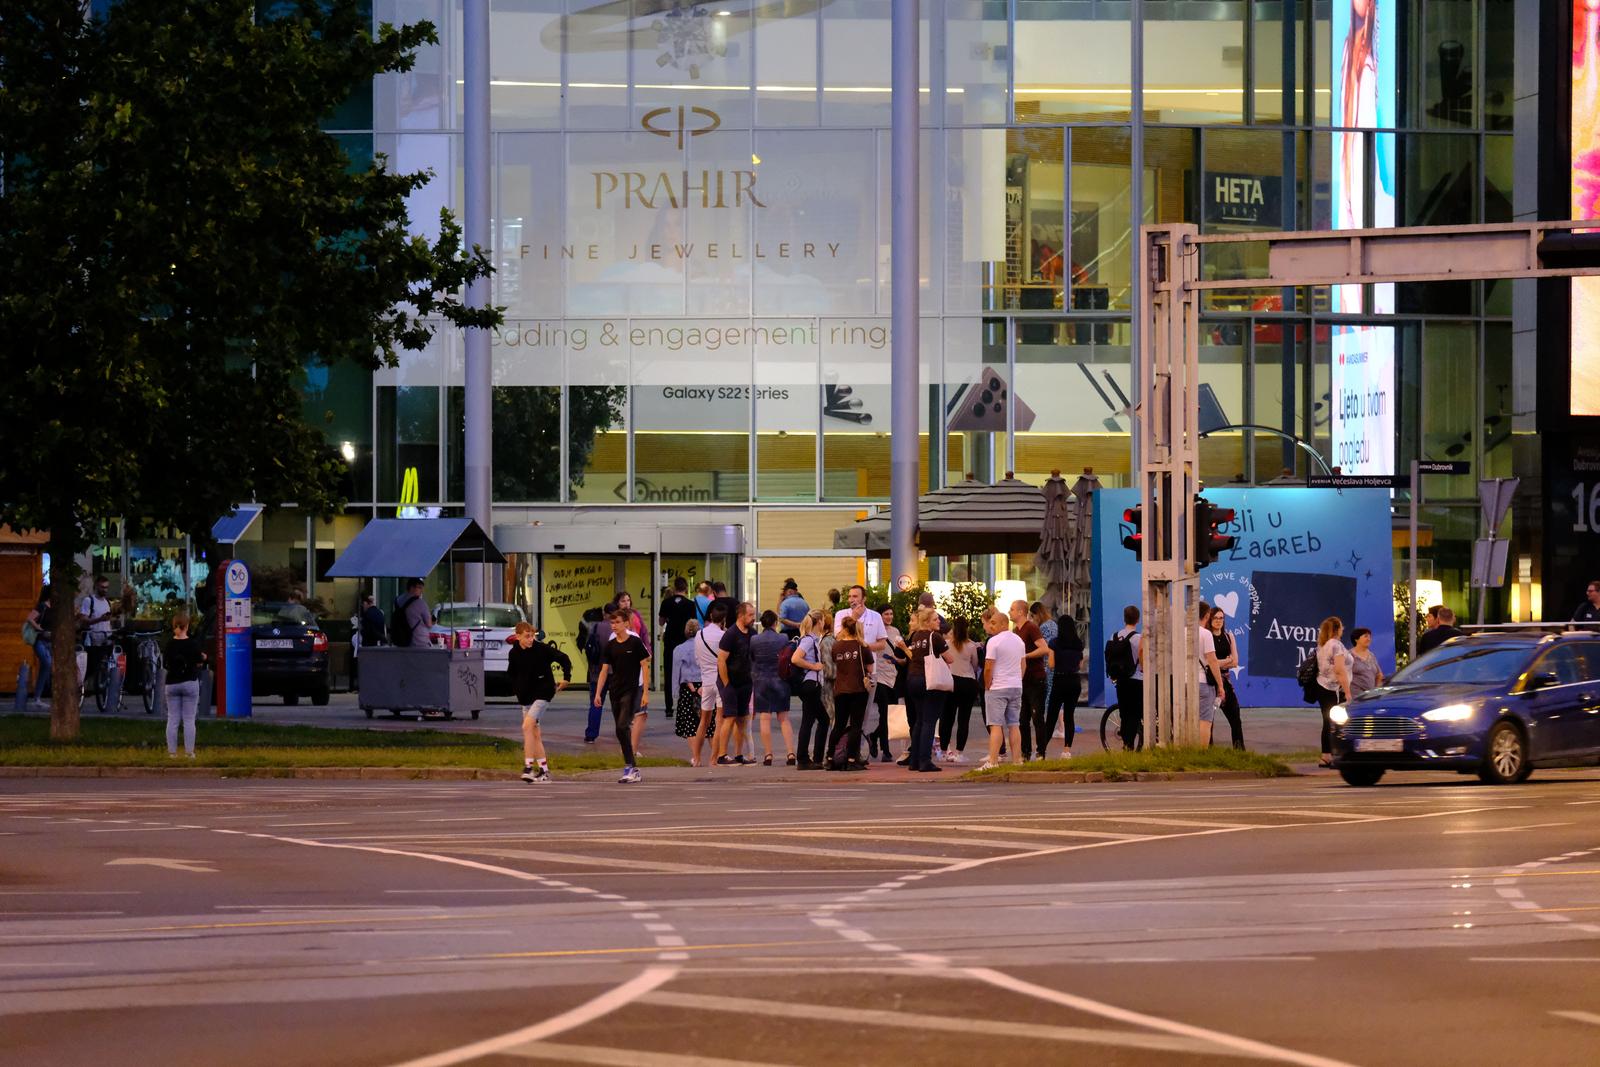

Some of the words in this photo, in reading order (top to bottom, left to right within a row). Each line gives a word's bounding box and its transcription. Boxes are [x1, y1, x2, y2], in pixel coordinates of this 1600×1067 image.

[591, 170, 768, 210] PRAHIR
[1215, 176, 1265, 205] HETA
[520, 244, 600, 261] FINE
[628, 242, 841, 260] JEWELLERY
[490, 322, 588, 351] edding
[599, 322, 619, 346] &
[629, 321, 819, 351] engagement
[830, 320, 892, 350] ring
[662, 386, 716, 402] Galaxy
[718, 387, 742, 399] S22
[1339, 388, 1359, 429] Ljeto
[1360, 394, 1366, 418] u
[1363, 477, 1392, 488] Holjevca
[1265, 617, 1320, 642] Aven
